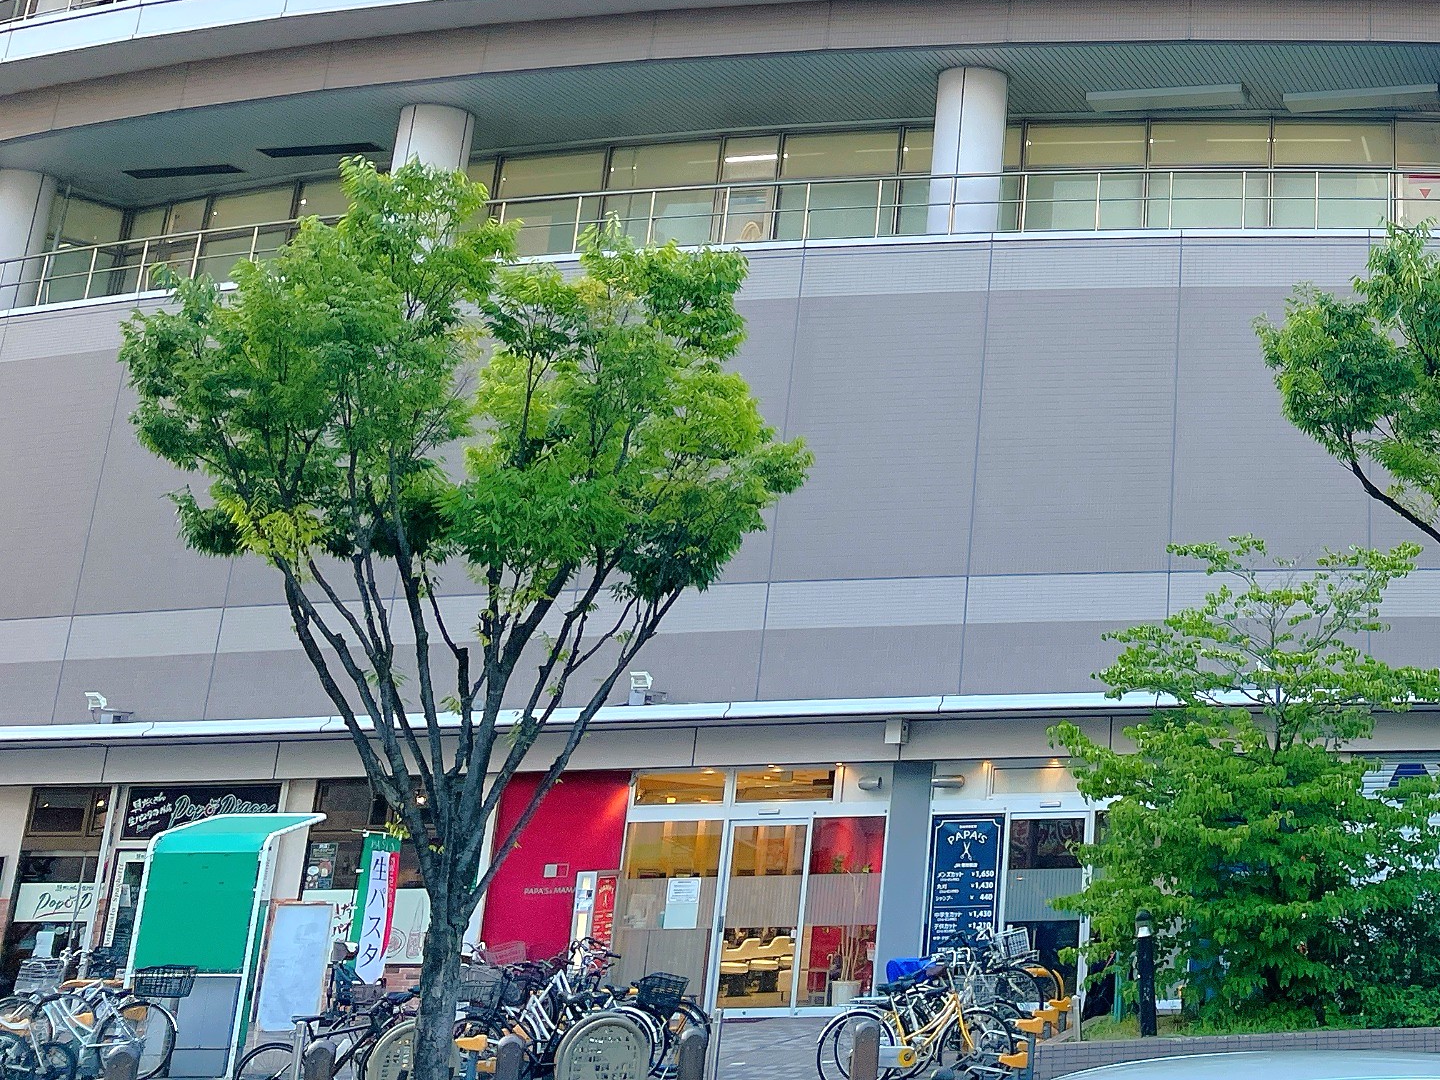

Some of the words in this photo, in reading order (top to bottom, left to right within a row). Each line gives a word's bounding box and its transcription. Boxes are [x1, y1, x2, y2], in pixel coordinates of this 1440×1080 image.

[947, 830, 988, 845] PAPA'S
[359, 857, 387, 968] 生パスタ
